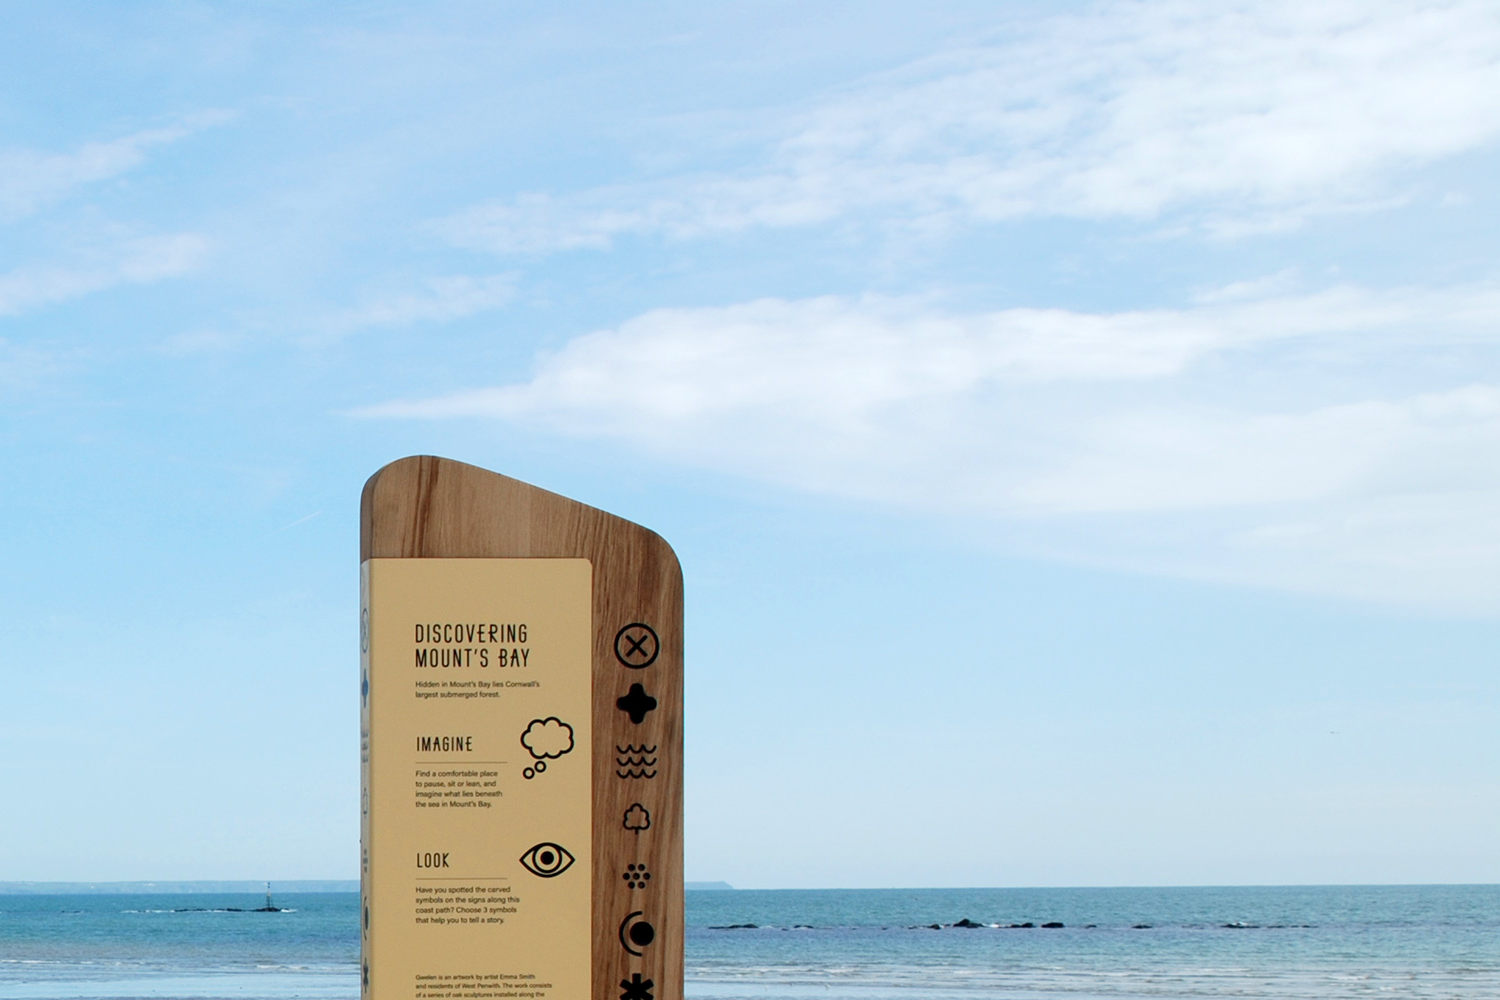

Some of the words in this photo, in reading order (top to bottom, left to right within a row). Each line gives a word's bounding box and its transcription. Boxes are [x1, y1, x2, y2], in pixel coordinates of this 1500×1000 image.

[415, 623, 527, 644] DISCOVERING
[415, 648, 489, 668] MOUNT'S
[498, 648, 530, 668] BAY
[449, 680, 477, 688] Mount's
[478, 680, 491, 689] Bay
[505, 680, 540, 688] Cornwall's
[415, 691, 439, 700] largest
[440, 691, 478, 700] submerged
[416, 736, 473, 752] IMAGINE
[415, 770, 431, 778] Find
[479, 770, 499, 778] place
[415, 790, 443, 799] imagine
[443, 790, 461, 798] what
[475, 790, 503, 798] beneath
[449, 800, 477, 808] Mount's
[417, 852, 450, 868] LOOK
[434, 887, 447, 895] you
[448, 886, 474, 894] spotted
[415, 896, 444, 905] symbols
[455, 896, 467, 904] the
[467, 896, 486, 905] signs
[487, 896, 506, 905] along
[435, 906, 455, 915] path?
[455, 906, 482, 914] Choose
[489, 906, 517, 915] symbols
[430, 916, 446, 925] help
[468, 916, 480, 924] tell
